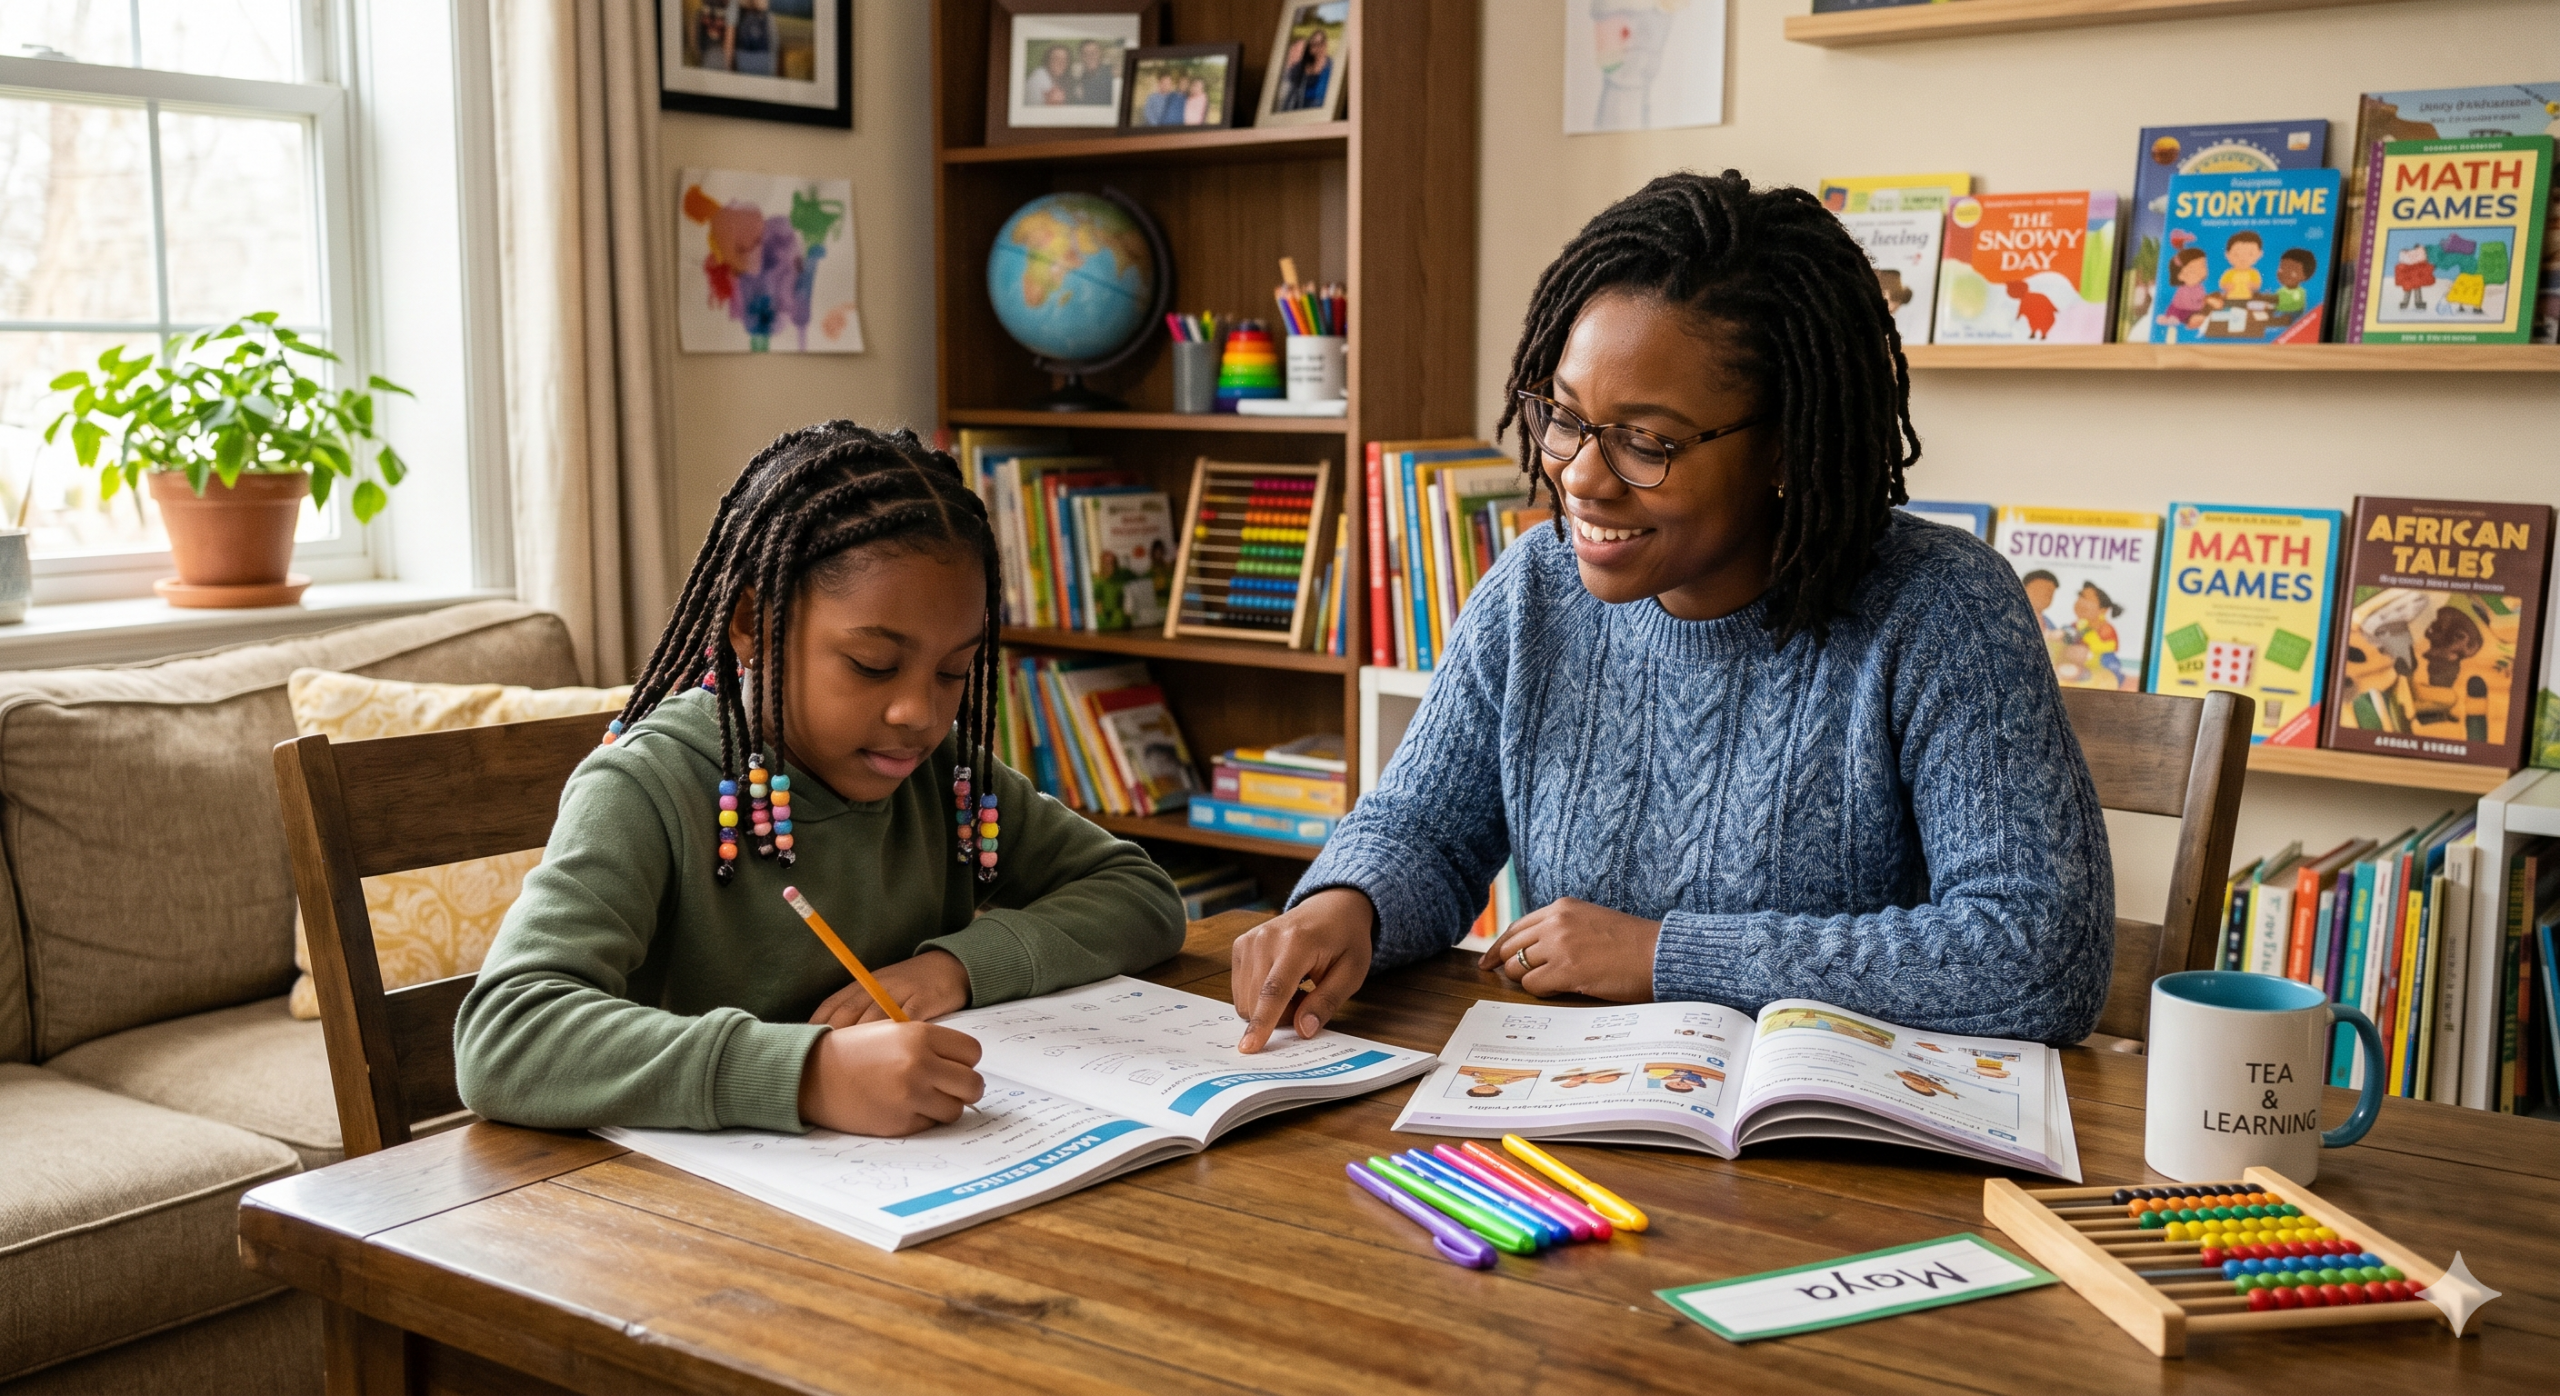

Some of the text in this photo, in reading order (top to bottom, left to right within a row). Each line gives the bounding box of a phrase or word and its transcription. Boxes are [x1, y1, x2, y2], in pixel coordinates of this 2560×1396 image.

[2395, 159, 2522, 192] MATH
[2175, 188, 2329, 218] STORYTIME
[2392, 194, 2517, 220] GAMES
[2009, 212, 2053, 227] THE
[1977, 229, 2082, 251] SNOWY
[2001, 252, 2057, 270] DAY
[2010, 531, 2143, 563] STORYTIME
[2366, 514, 2530, 550] AFRICAN
[2188, 531, 2311, 567] MATH
[2392, 546, 2496, 579] TALES
[2177, 567, 2313, 602] GAMES
[2246, 1063, 2294, 1084] TEA
[2262, 1090, 2278, 1109] &
[2203, 1110, 2316, 1135] LEARNING
[1039, 1134, 1101, 1165] MATH
